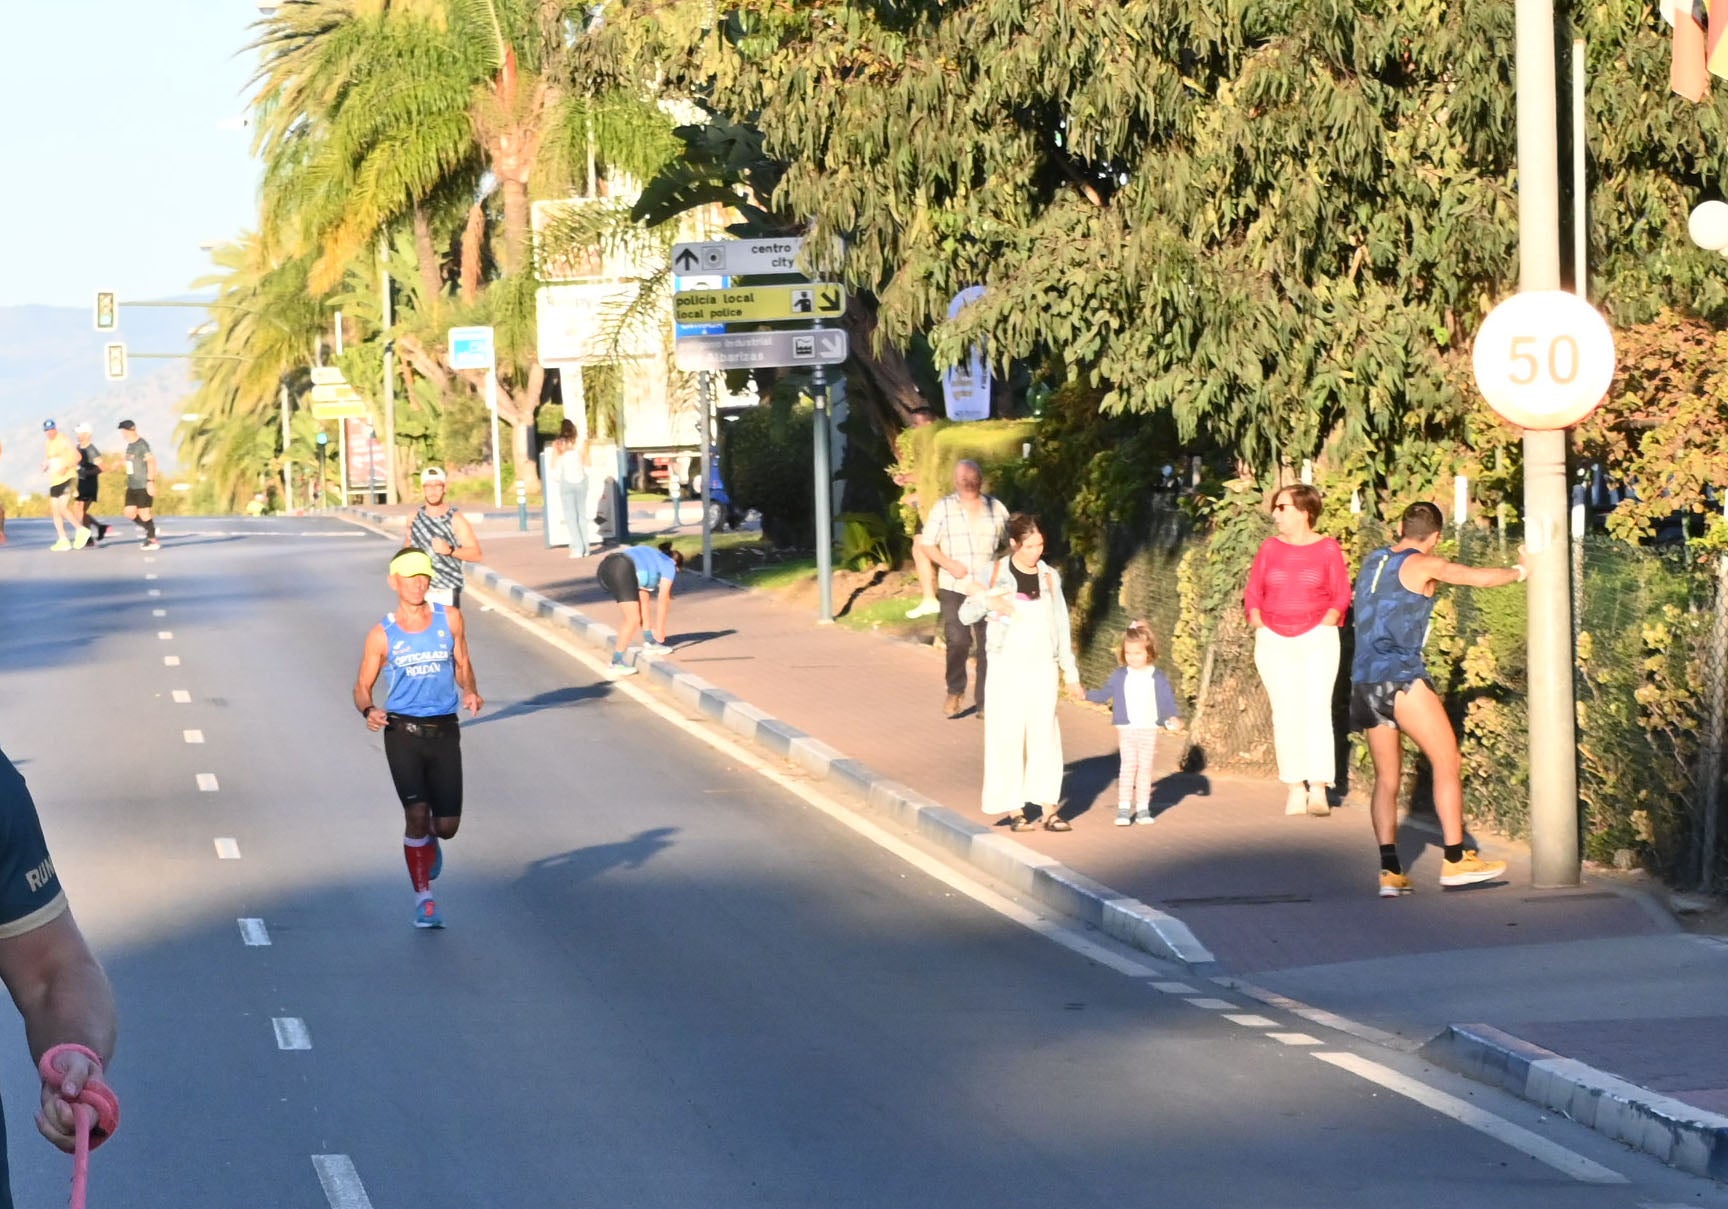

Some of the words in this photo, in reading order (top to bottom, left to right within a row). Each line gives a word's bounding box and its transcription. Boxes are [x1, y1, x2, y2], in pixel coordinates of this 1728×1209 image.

[751, 243, 792, 254] centro
[771, 257, 795, 268] city
[723, 292, 755, 304] local
[676, 309, 704, 319] local
[710, 308, 743, 319] police
[1508, 334, 1580, 386] 50
